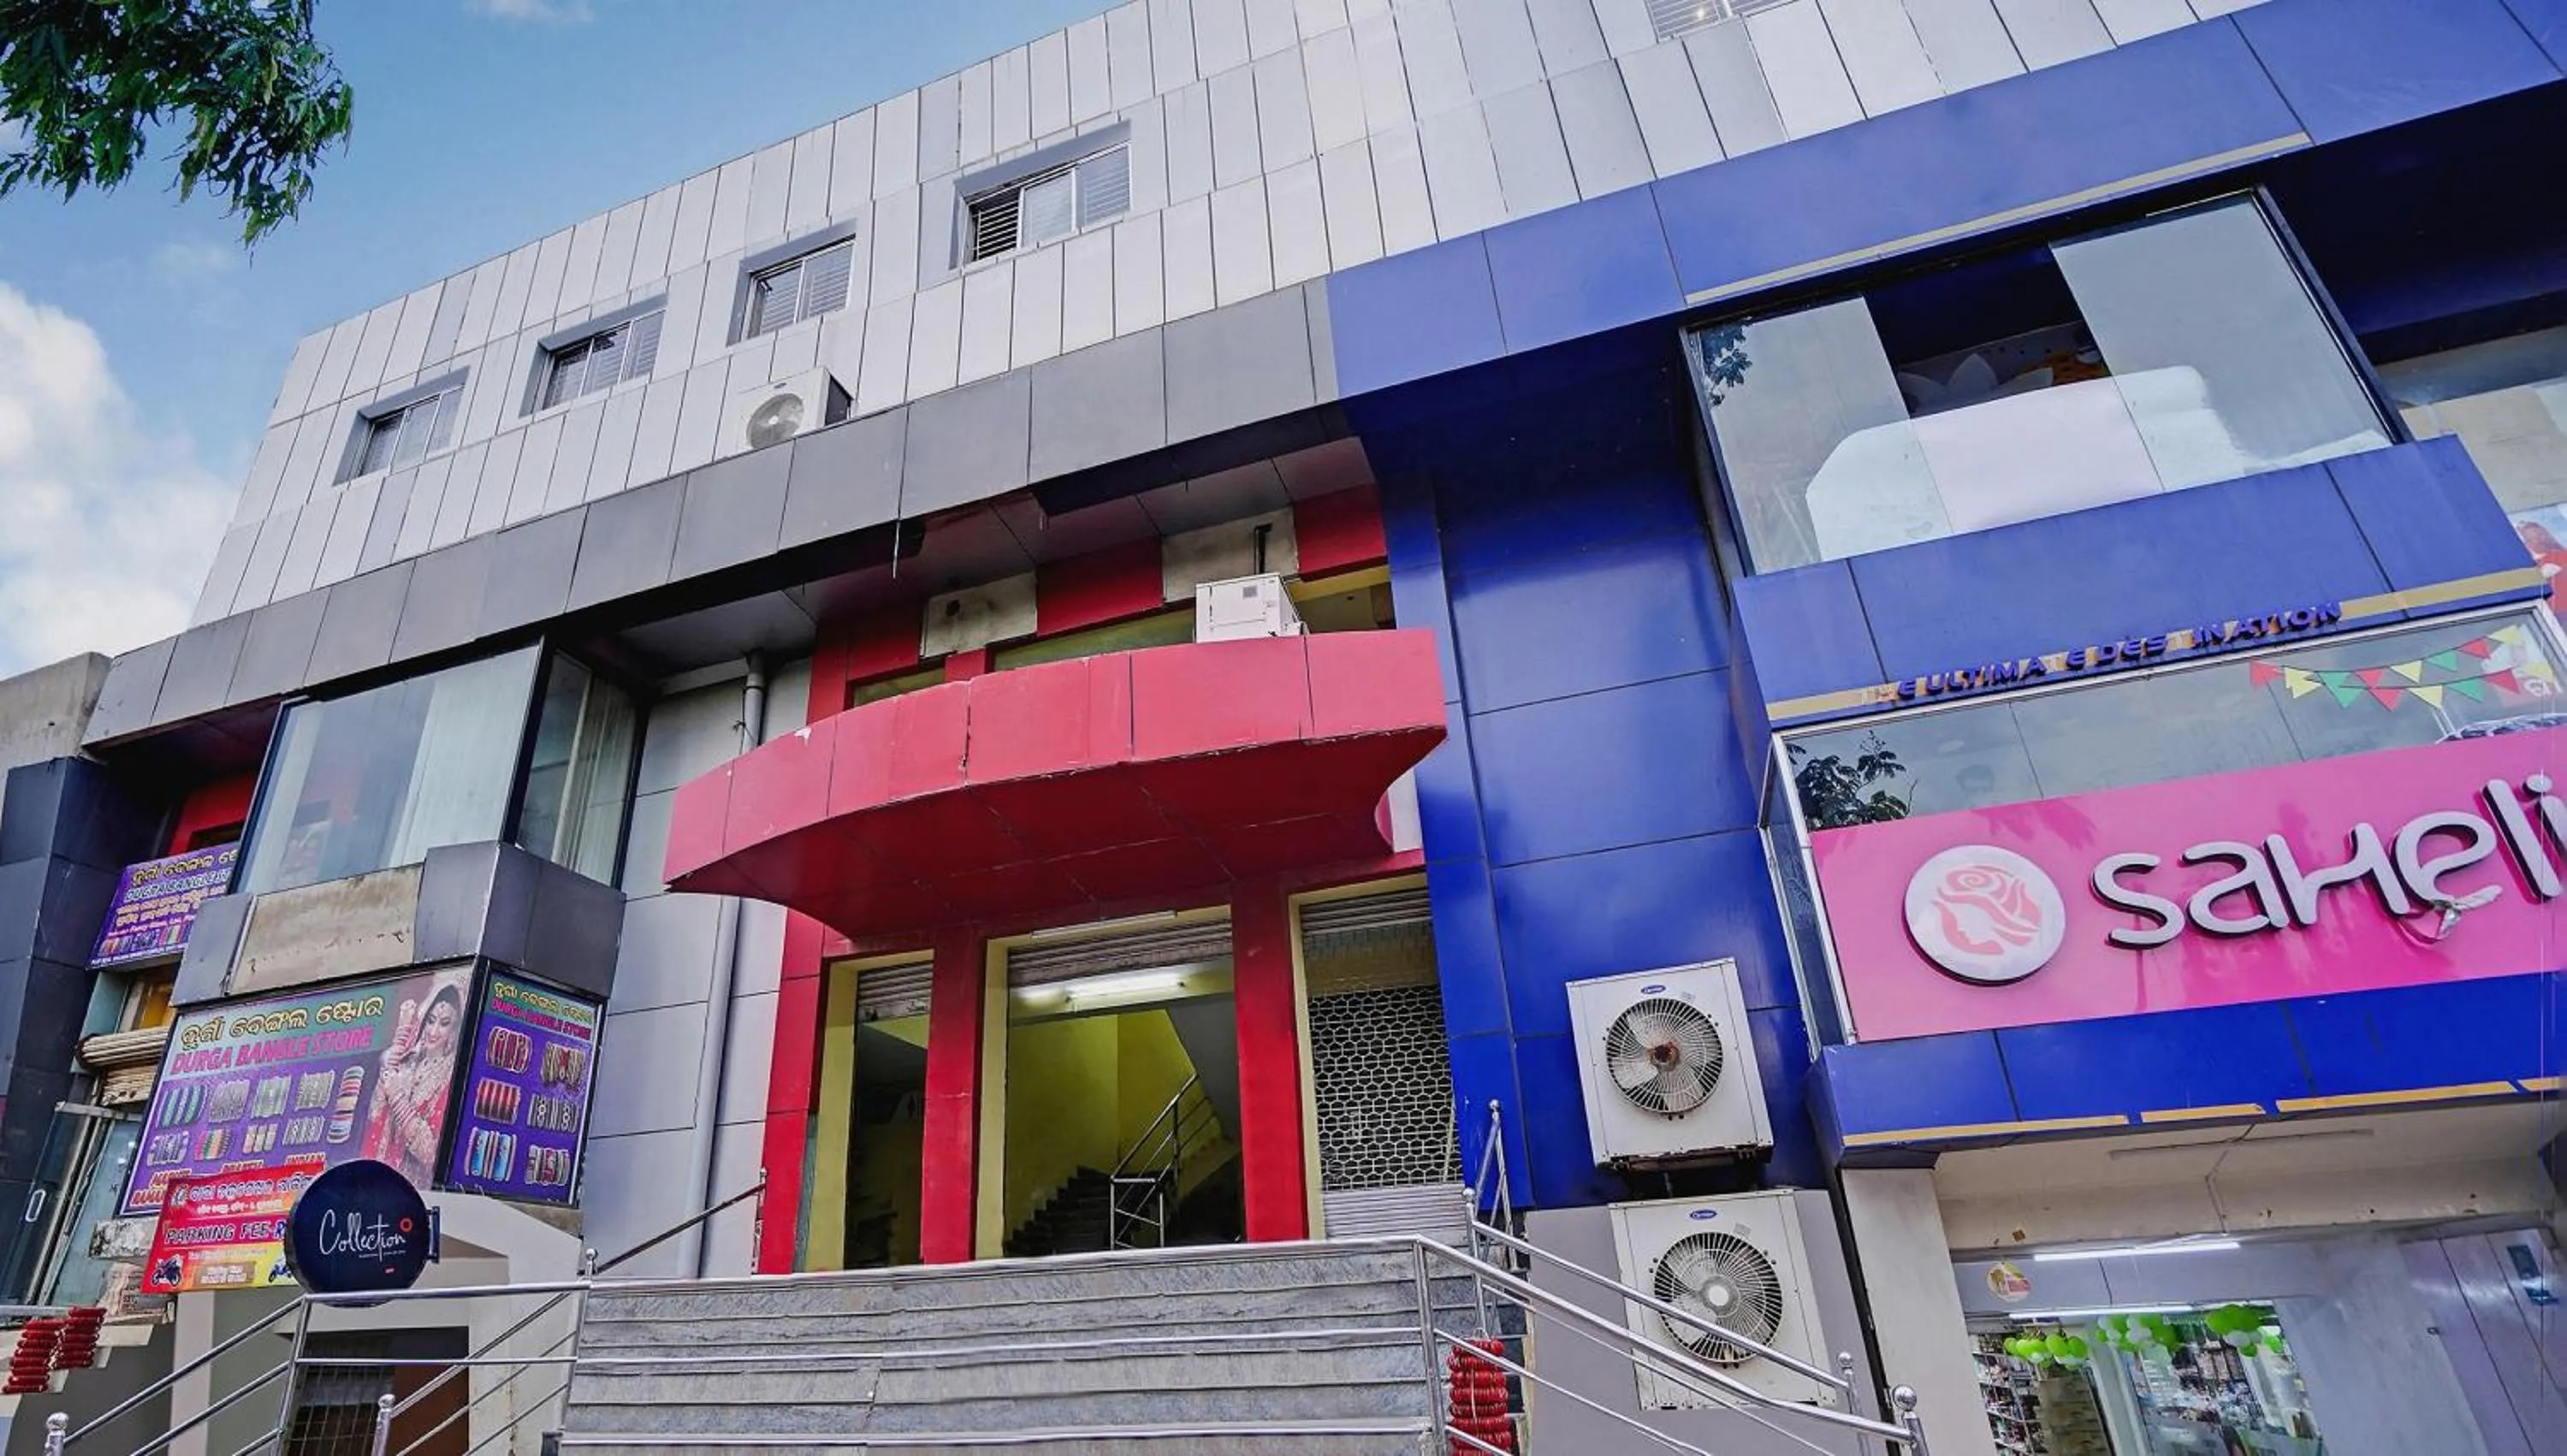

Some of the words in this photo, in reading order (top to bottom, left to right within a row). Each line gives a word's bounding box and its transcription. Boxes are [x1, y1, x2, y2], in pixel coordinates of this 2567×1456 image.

[170, 1045, 234, 1074] DURGA
[235, 1036, 309, 1067] BANGLE
[311, 1024, 375, 1056] STORE
[164, 1222, 235, 1245] PARKING
[318, 1208, 406, 1263] Collection
